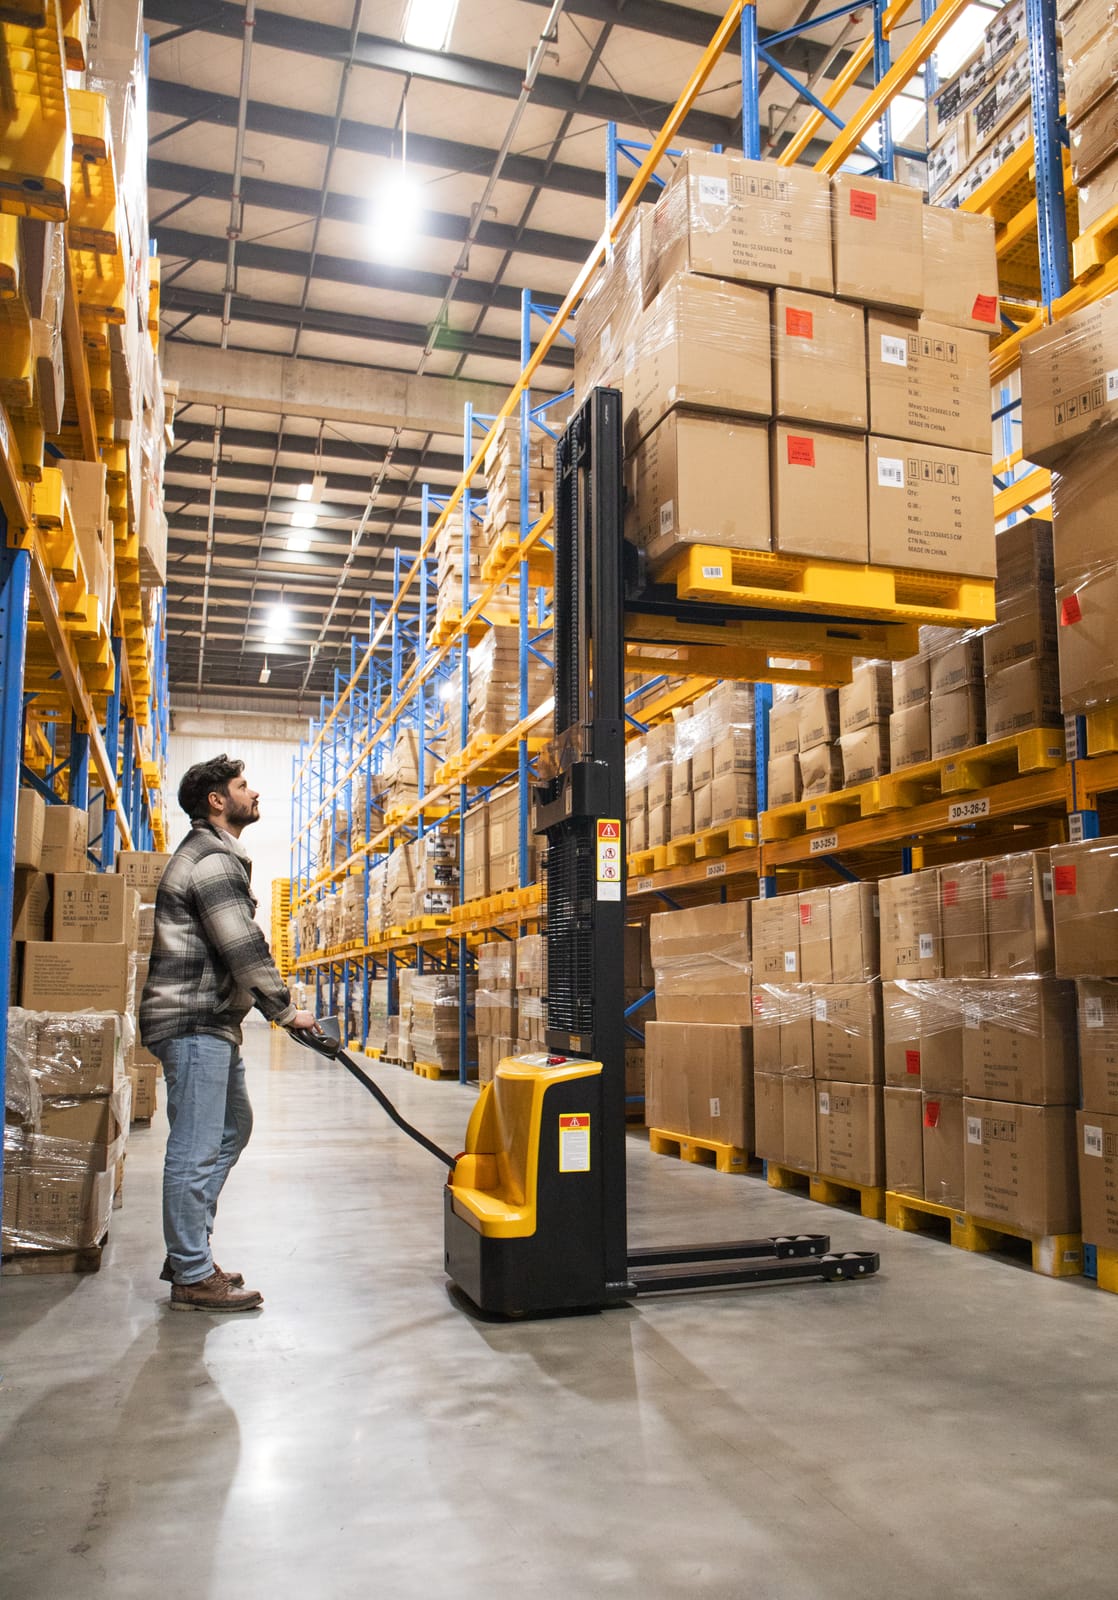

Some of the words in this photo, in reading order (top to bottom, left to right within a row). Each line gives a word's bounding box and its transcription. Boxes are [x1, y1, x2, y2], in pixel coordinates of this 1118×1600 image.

[733, 258, 750, 266] MADE
[759, 262, 776, 270] CHINA
[908, 420, 923, 428] MADE
[930, 424, 946, 432] CHINA
[908, 546, 924, 554] MADE
[931, 548, 947, 556] CHINA
[951, 801, 986, 818] 3D-3-26-2
[812, 837, 836, 850] 3D-3-25-2
